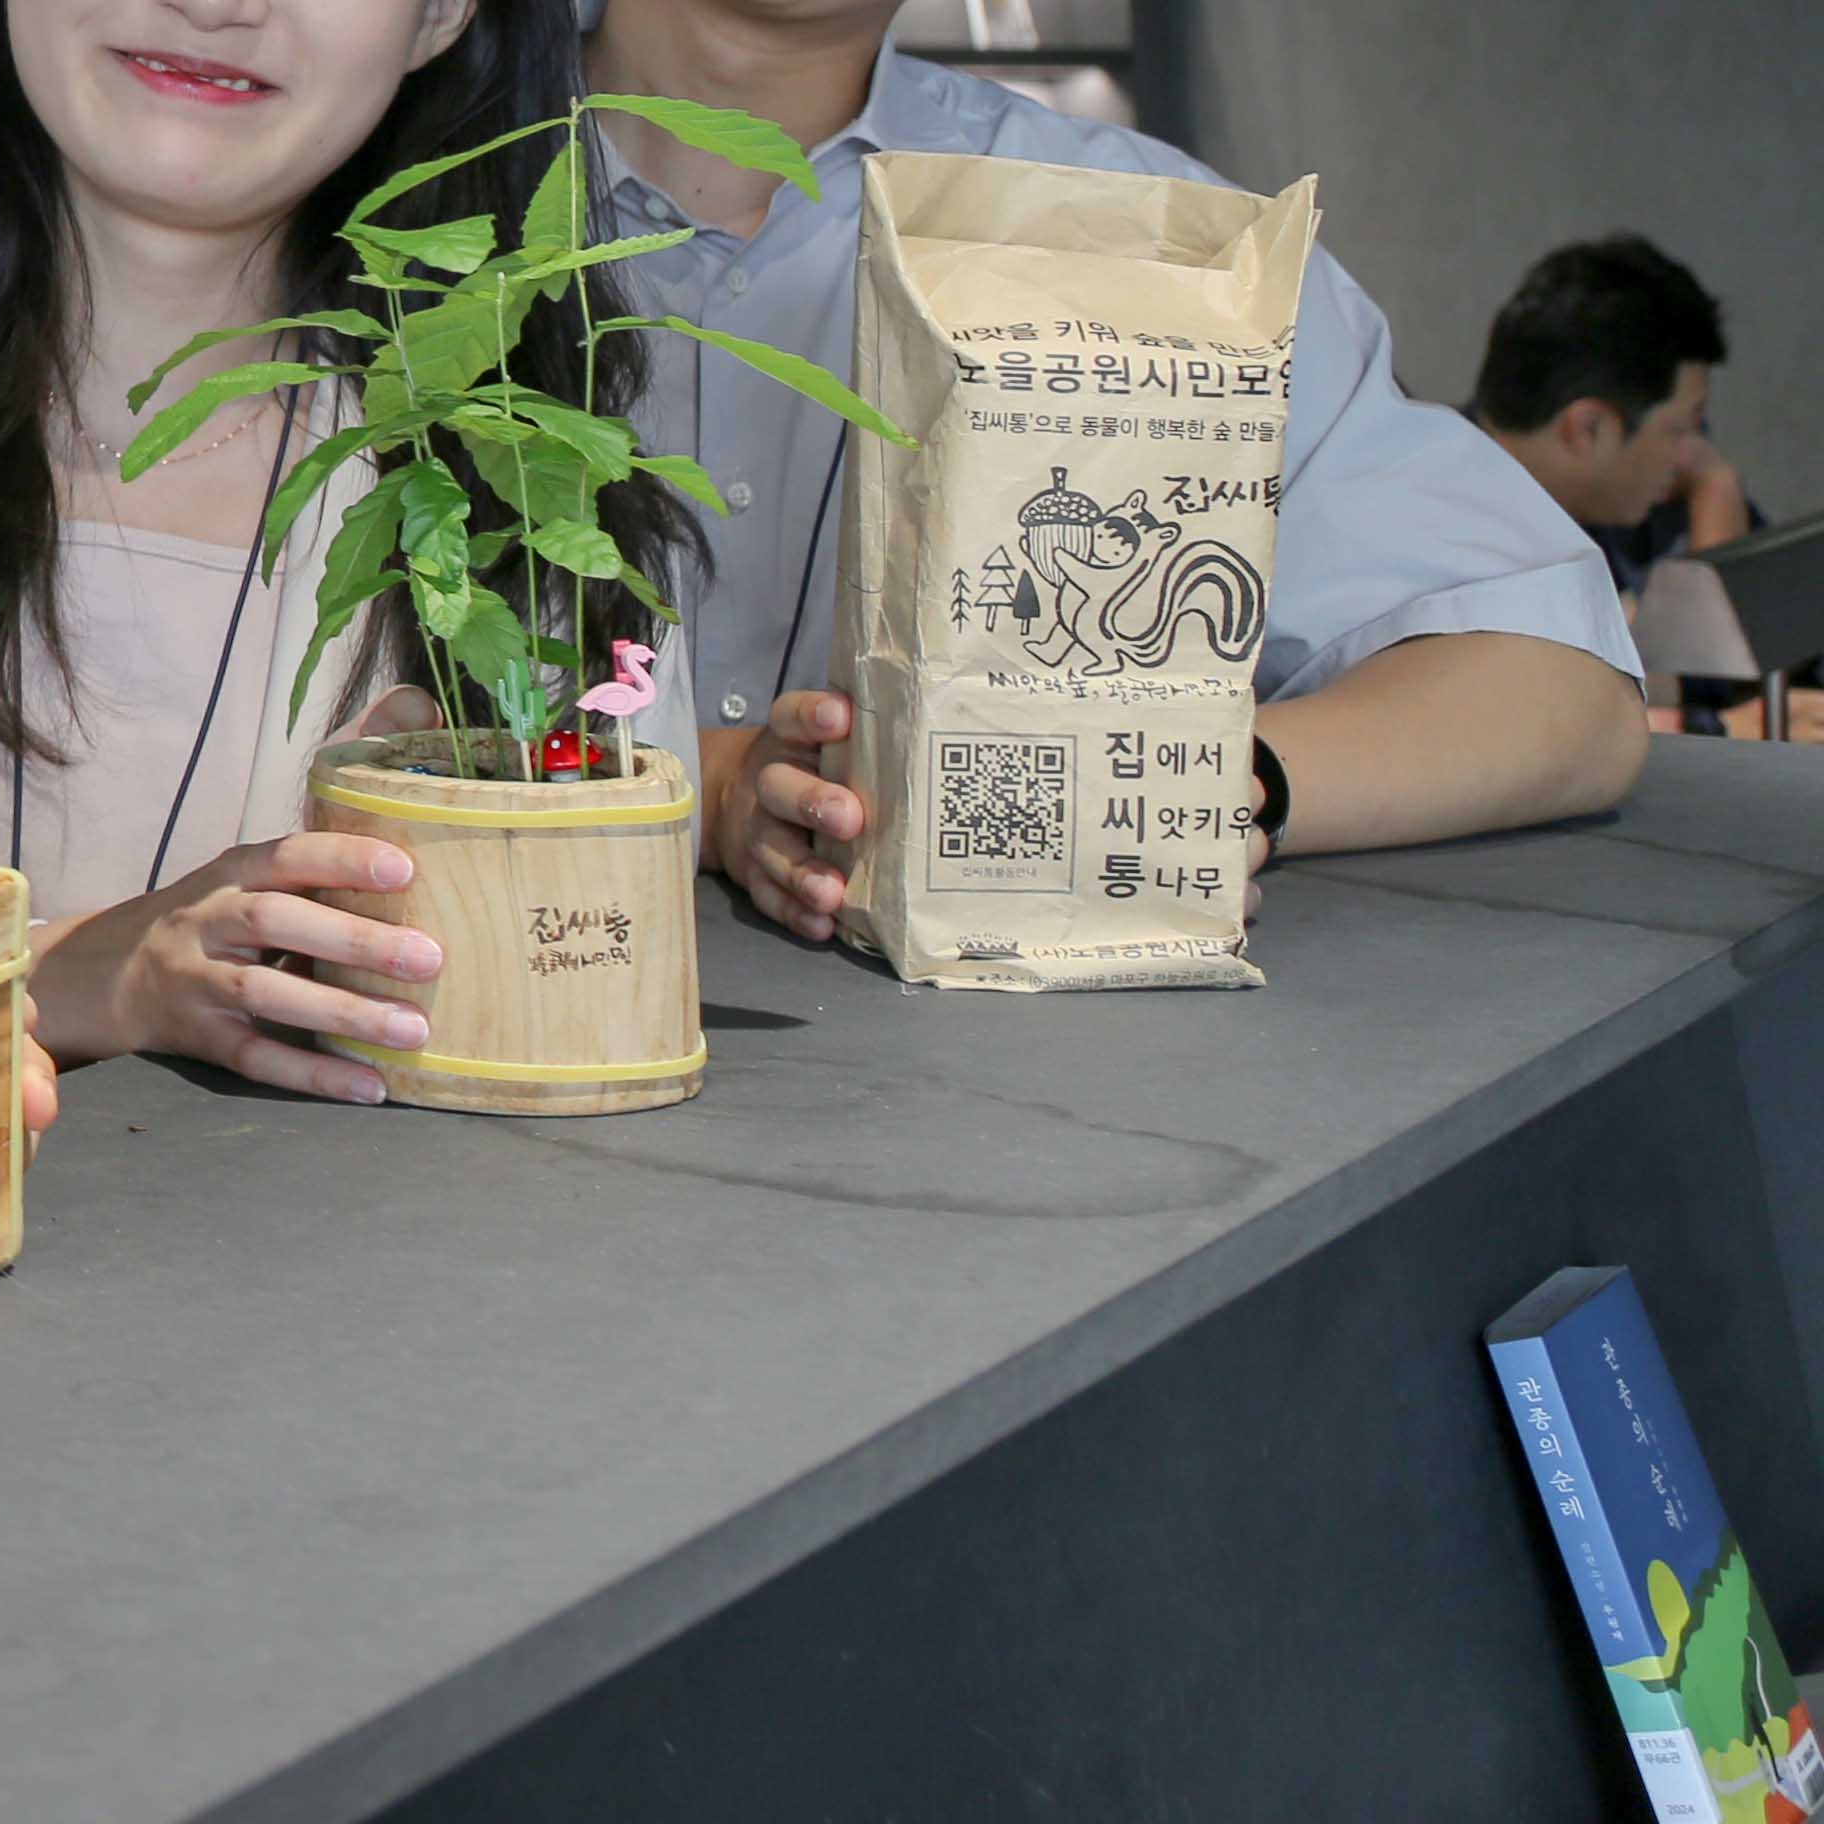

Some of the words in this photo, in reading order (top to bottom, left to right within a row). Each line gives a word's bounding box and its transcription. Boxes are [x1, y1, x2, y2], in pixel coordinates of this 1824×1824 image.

[1054, 319, 1120, 344] 키워
[1081, 415, 1140, 438] 동물이
[1147, 417, 1205, 441] 행복한
[1212, 420, 1232, 442] 숲
[1240, 420, 1279, 443] 만들
[1105, 731, 1223, 779] 집에서
[1098, 853, 1224, 899] 통나무
[1516, 1376, 1563, 1459] 관종의
[1549, 1469, 1585, 1521] 순례
[1665, 1803, 1696, 1816] 2024
